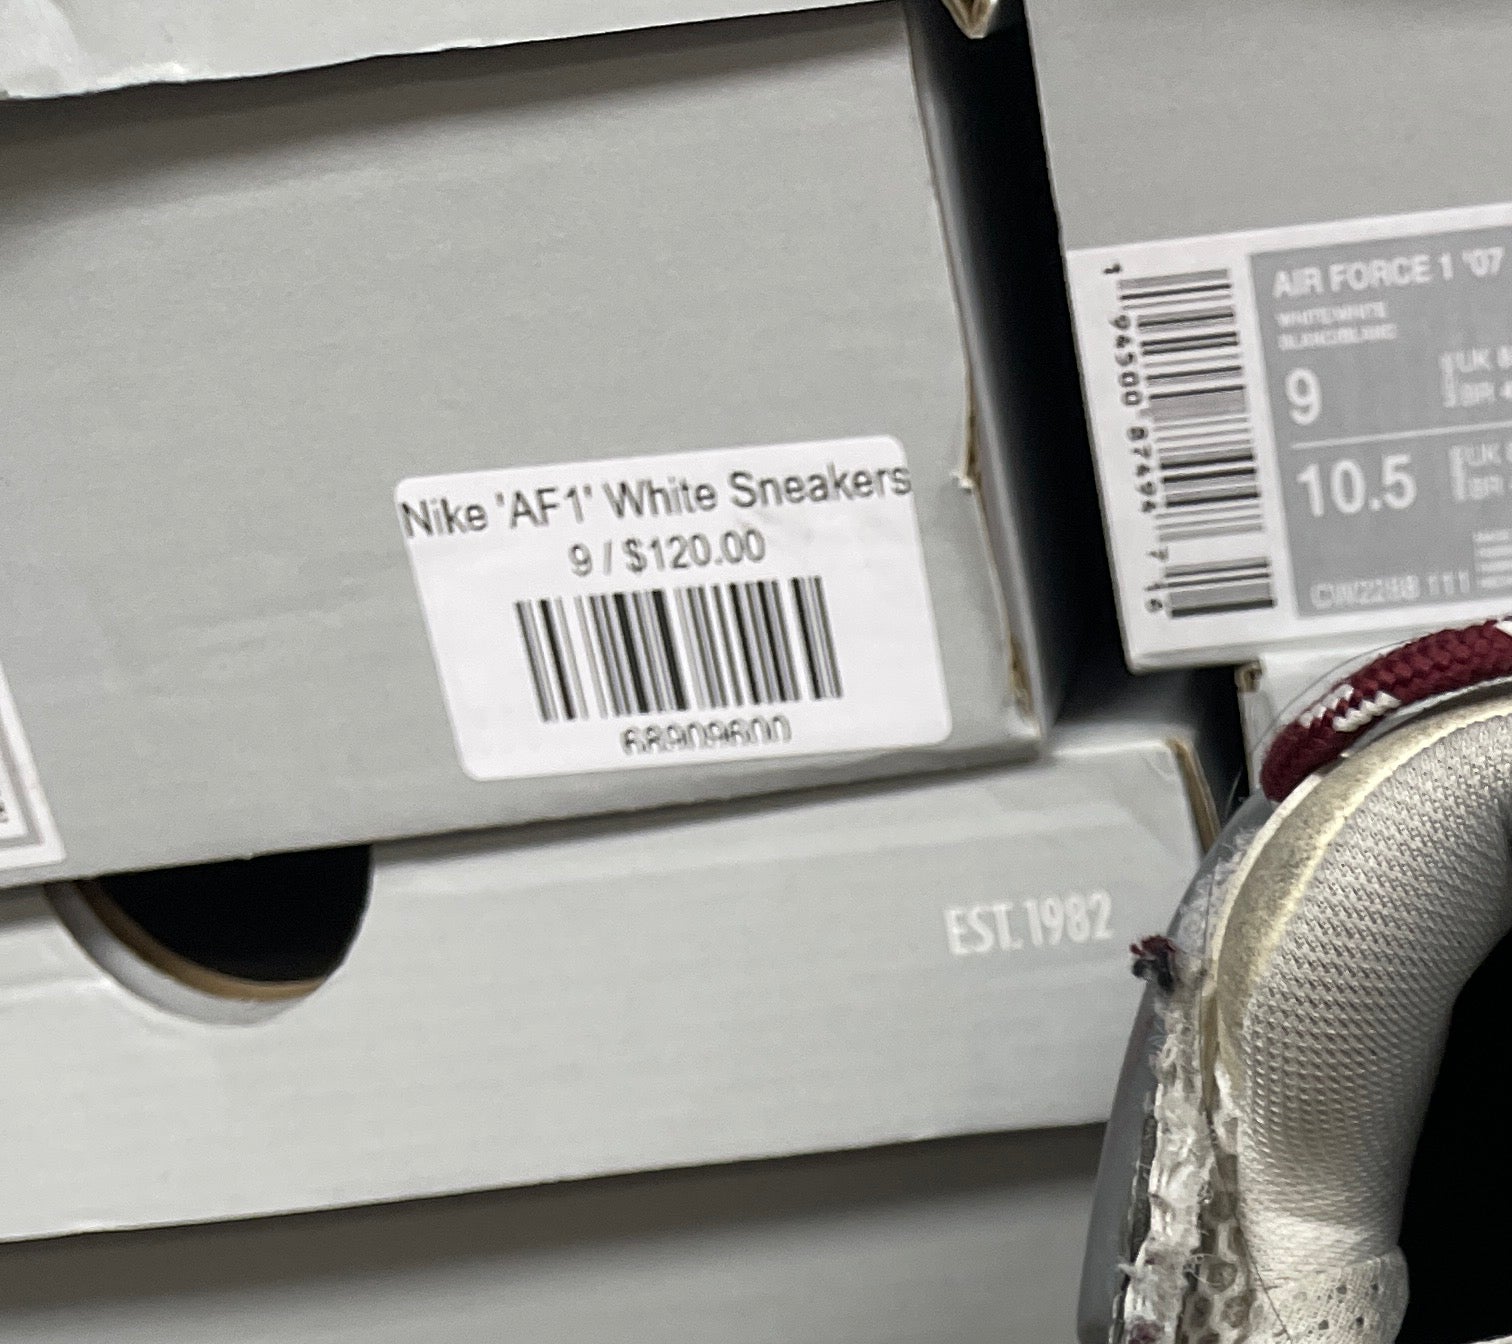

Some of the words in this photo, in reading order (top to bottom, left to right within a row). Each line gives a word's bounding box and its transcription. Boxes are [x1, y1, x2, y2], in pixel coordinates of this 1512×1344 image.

[1273, 266, 1324, 299] AIR
[1328, 254, 1432, 292] FORCE
[1438, 252, 1453, 280] 1
[1462, 246, 1505, 277] '07
[1285, 368, 1322, 425] 9
[401, 498, 487, 539] Nike
[498, 484, 594, 530] 'AF1'
[605, 476, 718, 520] White
[730, 463, 912, 509] Sneakers
[1296, 455, 1417, 517] 10.5
[568, 542, 593, 577] 9
[625, 526, 767, 574] $120.00
[1023, 888, 1115, 947] 1982
